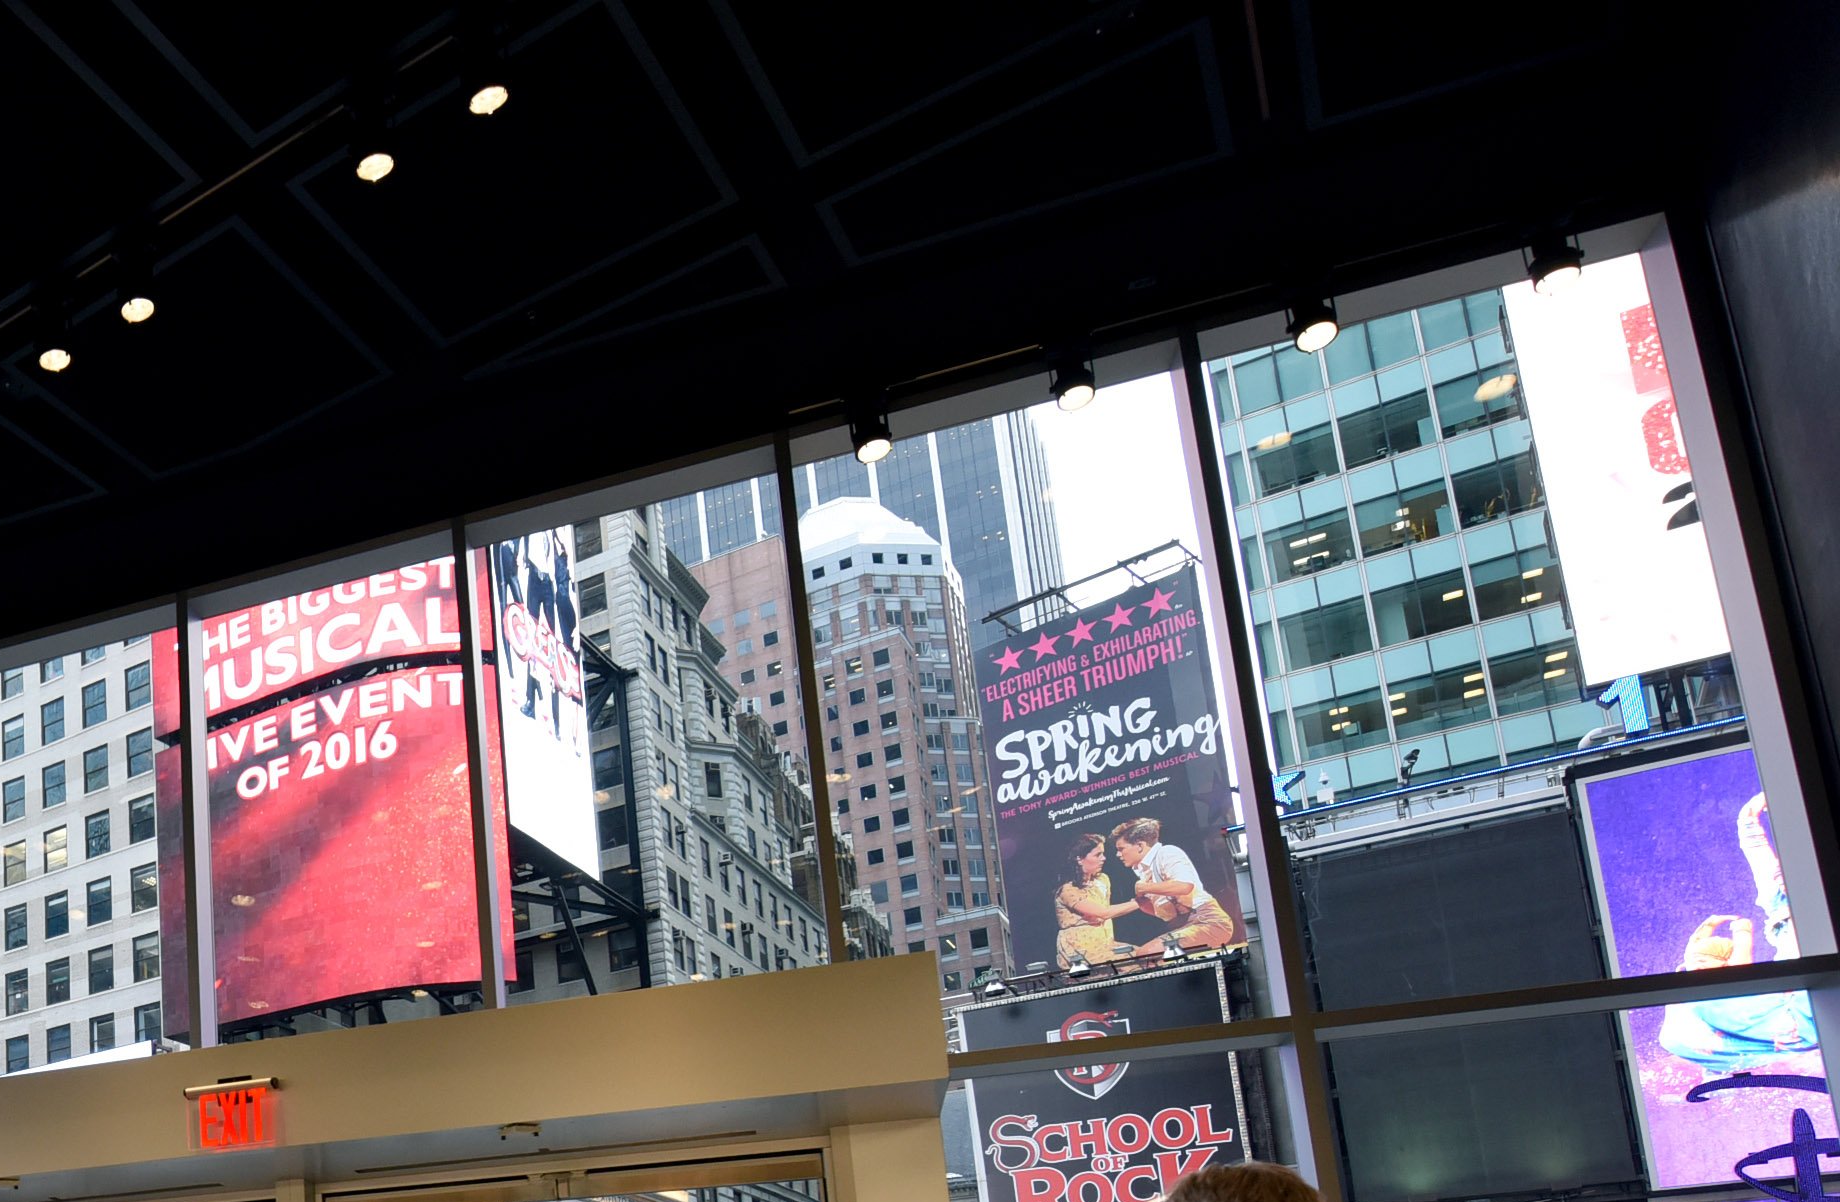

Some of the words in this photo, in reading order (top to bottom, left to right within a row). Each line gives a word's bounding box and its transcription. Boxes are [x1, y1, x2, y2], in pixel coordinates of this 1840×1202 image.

[203, 613, 251, 661] HE
[261, 555, 456, 635] BIGGEST
[1080, 655, 1090, 667] &
[1092, 609, 1201, 662] EXHILARATING.
[207, 715, 278, 769] IVE
[291, 668, 464, 740] EVENT
[1001, 699, 1015, 722] A
[1018, 676, 1078, 716] SHEER
[236, 754, 290, 798] OF
[299, 720, 398, 781] 2016
[995, 697, 1158, 780] SPRING
[996, 713, 1222, 803] awakening
[1000, 808, 1017, 820] THE
[1018, 801, 1042, 815] TONY
[1044, 774, 1126, 807] AWARD-WINNING
[1128, 766, 1150, 780] BEST
[1153, 751, 1200, 772] MUSICAL
[199, 1087, 267, 1148] EXIT
[985, 1103, 1233, 1174] SCHOOL
[1091, 1153, 1130, 1173] OF
